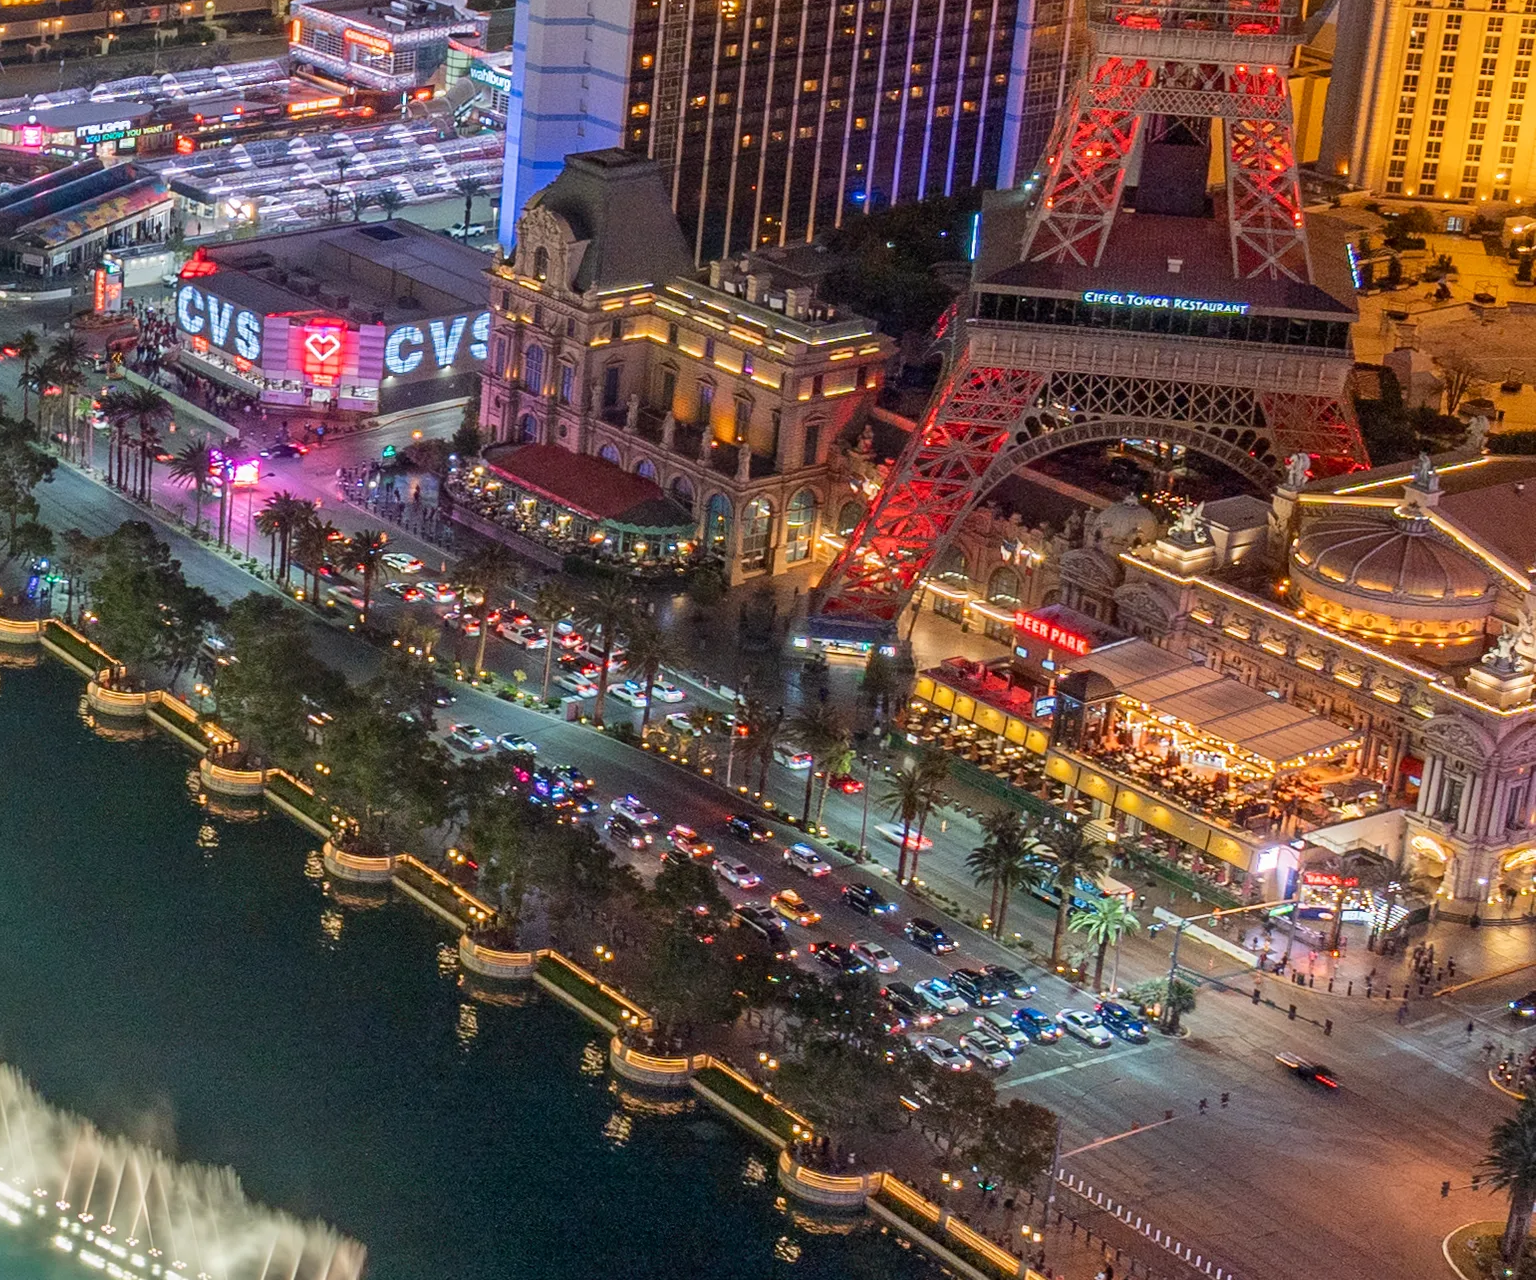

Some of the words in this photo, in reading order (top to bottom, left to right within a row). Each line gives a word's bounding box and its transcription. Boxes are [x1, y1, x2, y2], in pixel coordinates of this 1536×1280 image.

[470, 67, 512, 93] wahlburg
[85, 134, 101, 144] YOU
[102, 131, 125, 142] KNOW
[126, 128, 142, 138] YOU
[1084, 291, 1124, 305] EIFFEL
[1127, 294, 1169, 309] TOWER
[1173, 298, 1248, 315] RESTAURANT
[177, 285, 262, 361] CVS
[384, 311, 491, 374] CVS
[1015, 612, 1048, 637] BEER
[1050, 628, 1086, 655] PARK
